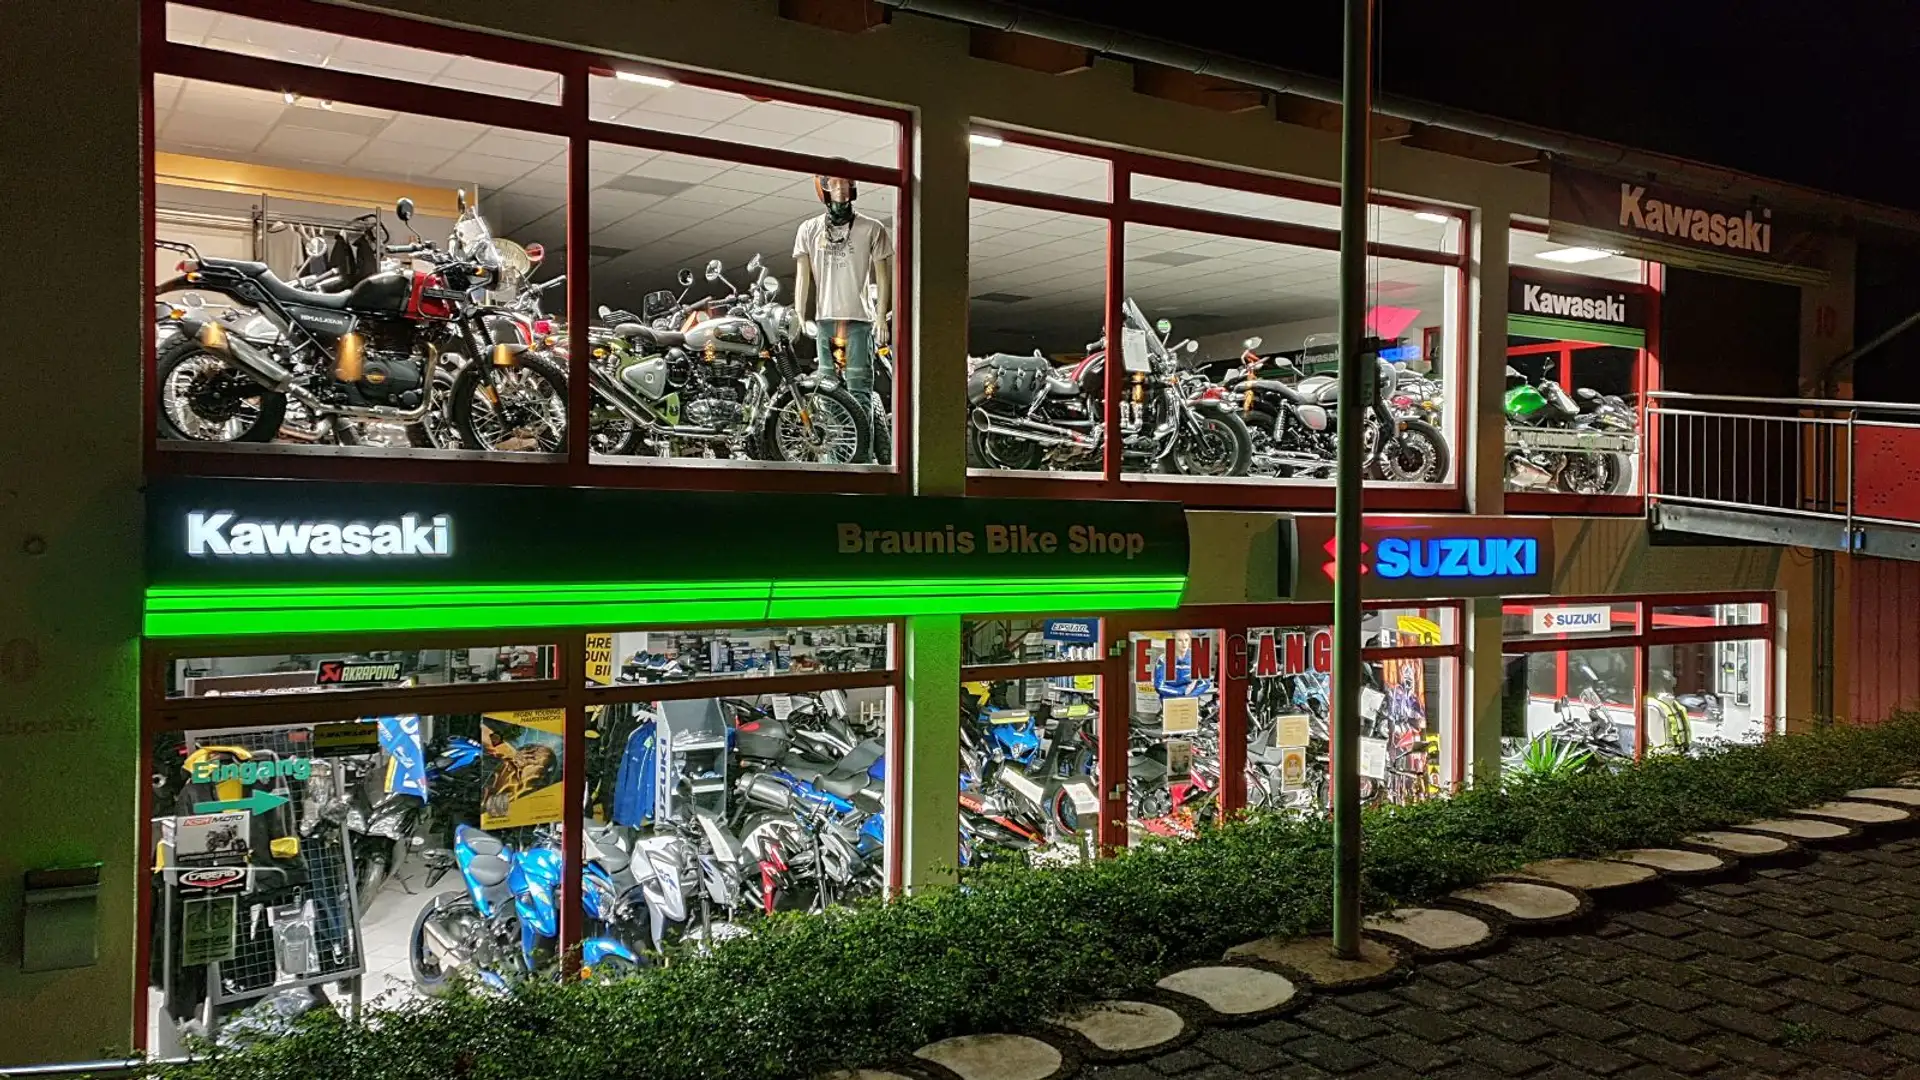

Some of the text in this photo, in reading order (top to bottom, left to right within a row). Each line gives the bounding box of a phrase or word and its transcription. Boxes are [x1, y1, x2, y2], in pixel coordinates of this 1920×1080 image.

[1619, 183, 1772, 253] Kawasaki
[1523, 284, 1625, 322] Kawasaki
[187, 511, 450, 555] Kawasaki
[837, 523, 1144, 559] Braunis Bike Shop
[1376, 537, 1537, 578] SUZUKI
[1556, 613, 1601, 625] SUZUKI
[1135, 631, 1333, 682] EINGANG
[192, 757, 312, 785] Eingang
